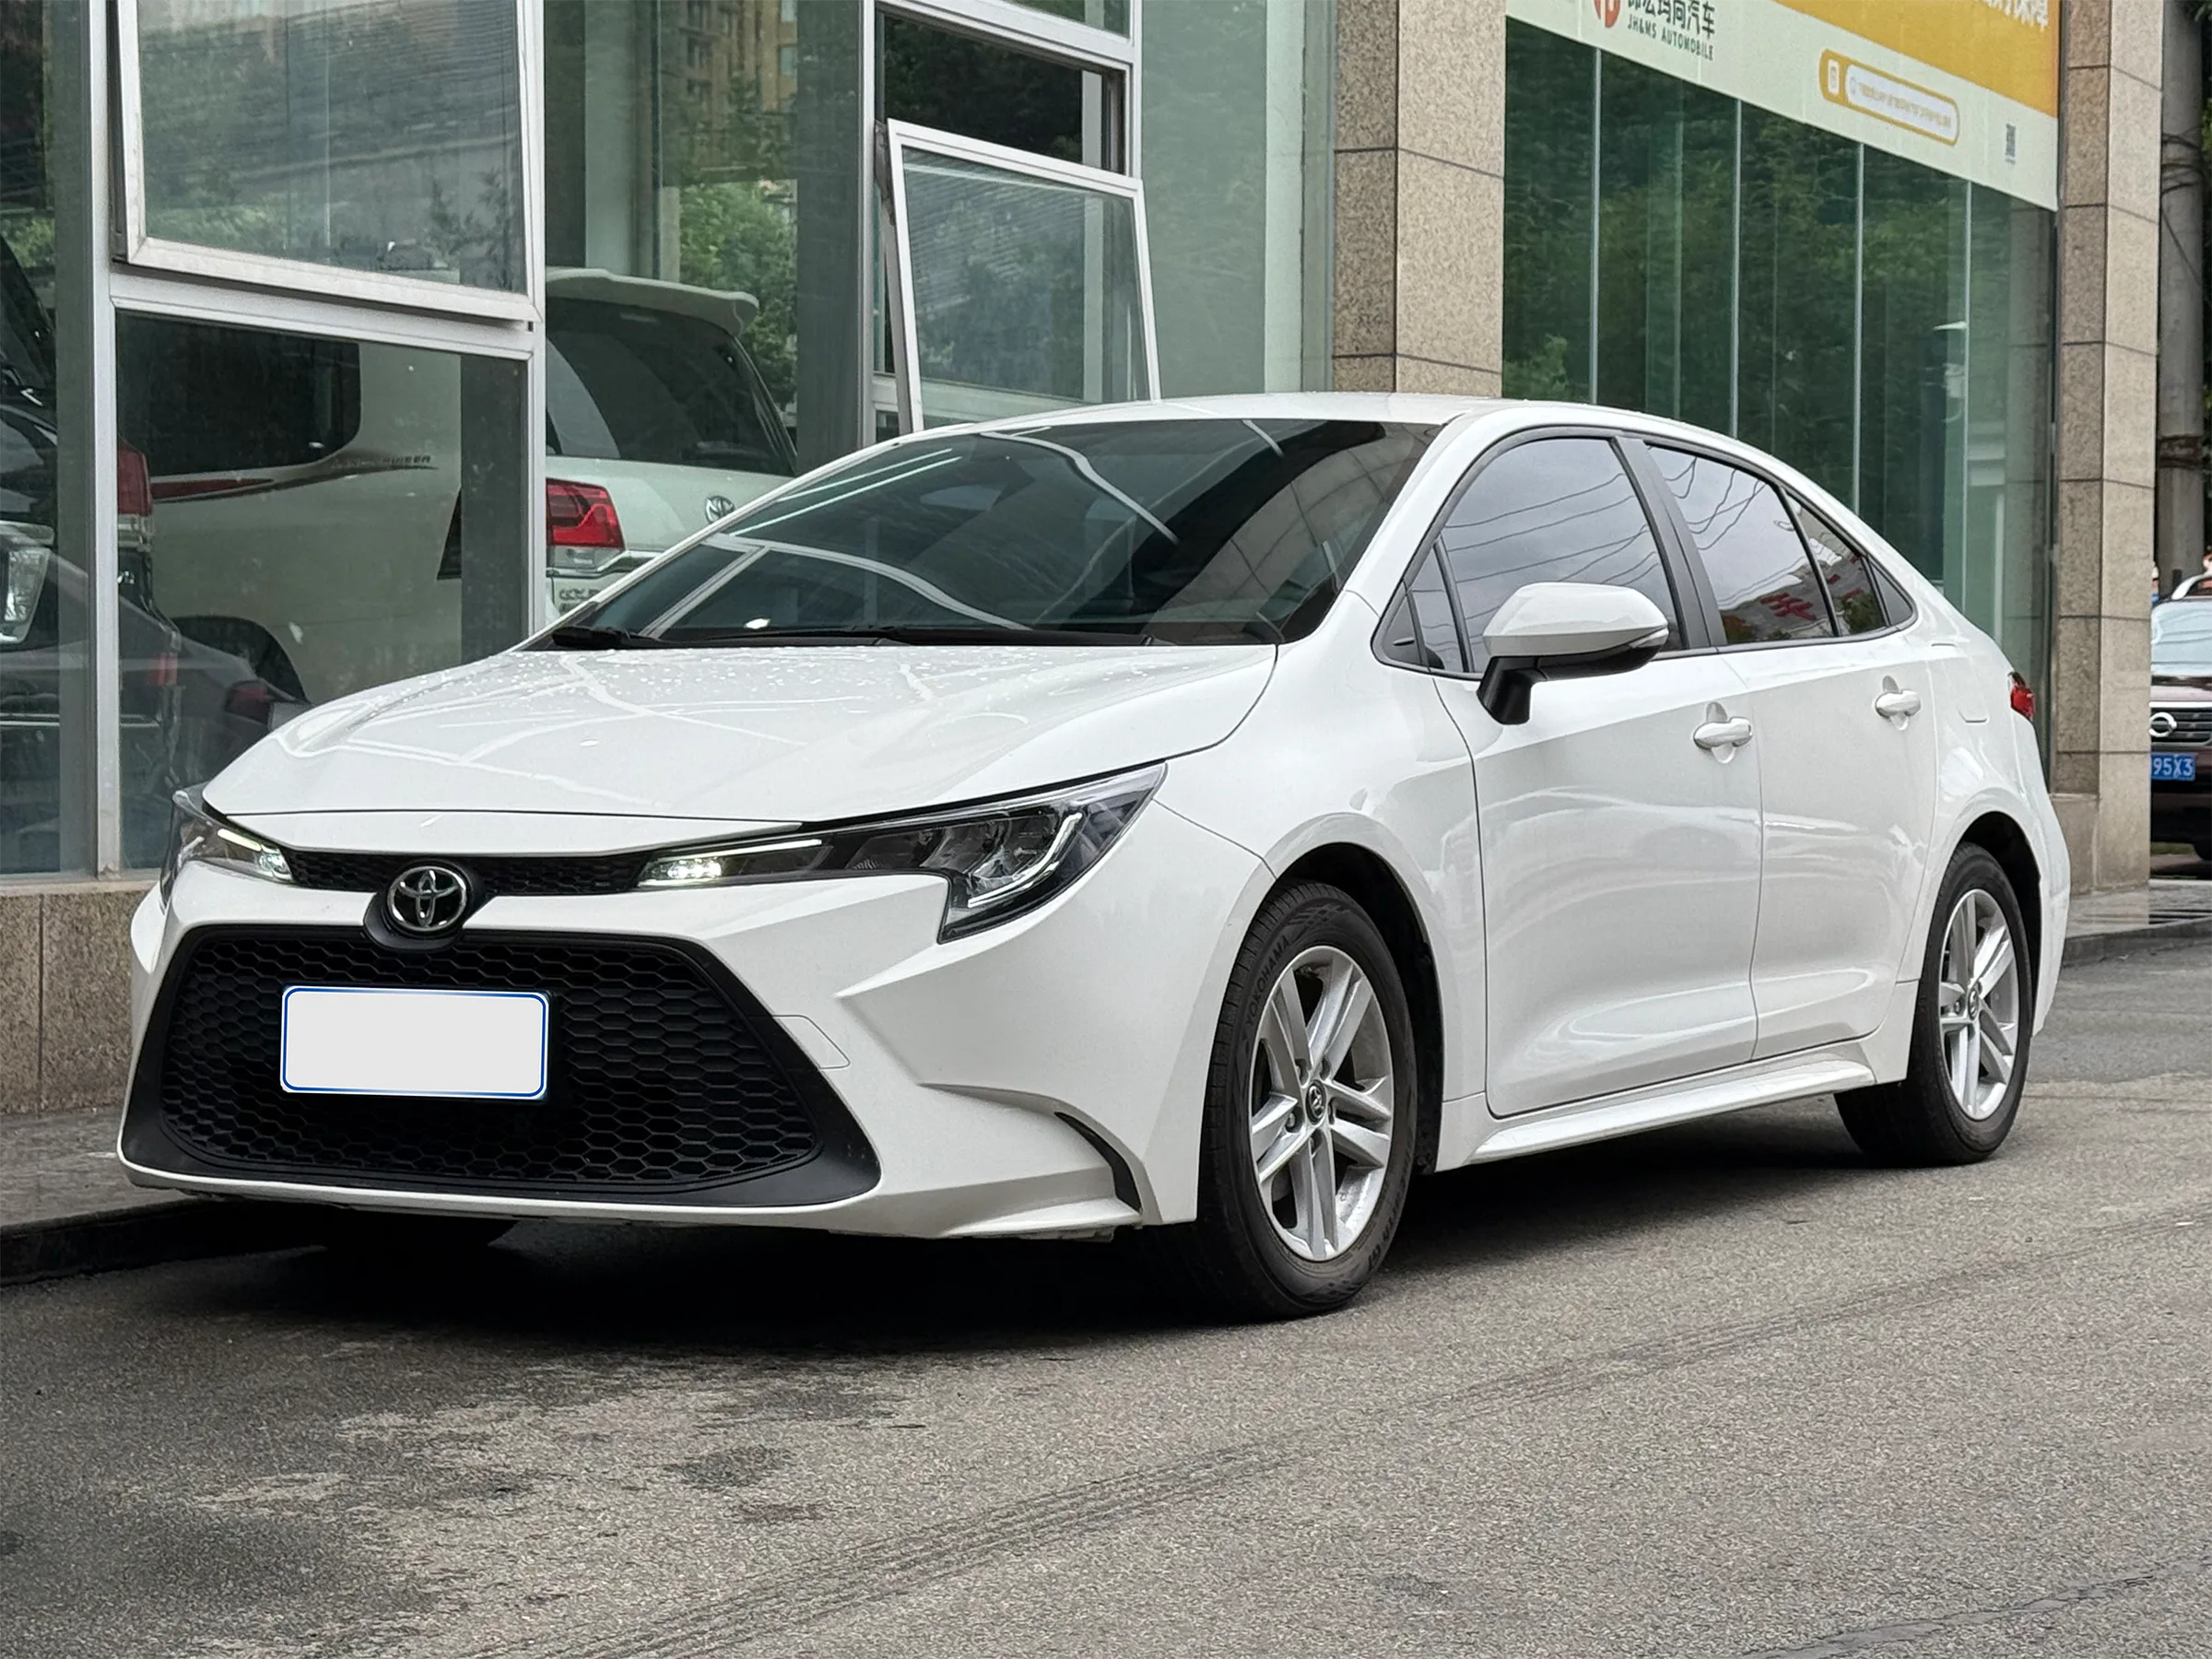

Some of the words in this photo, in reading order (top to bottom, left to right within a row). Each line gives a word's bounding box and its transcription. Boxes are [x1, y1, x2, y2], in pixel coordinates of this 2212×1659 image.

[1662, 27, 1713, 61] AUTOMOBILE
[2153, 757, 2194, 776] 95X3
[1244, 934, 1290, 1026] YOKOHAMA
